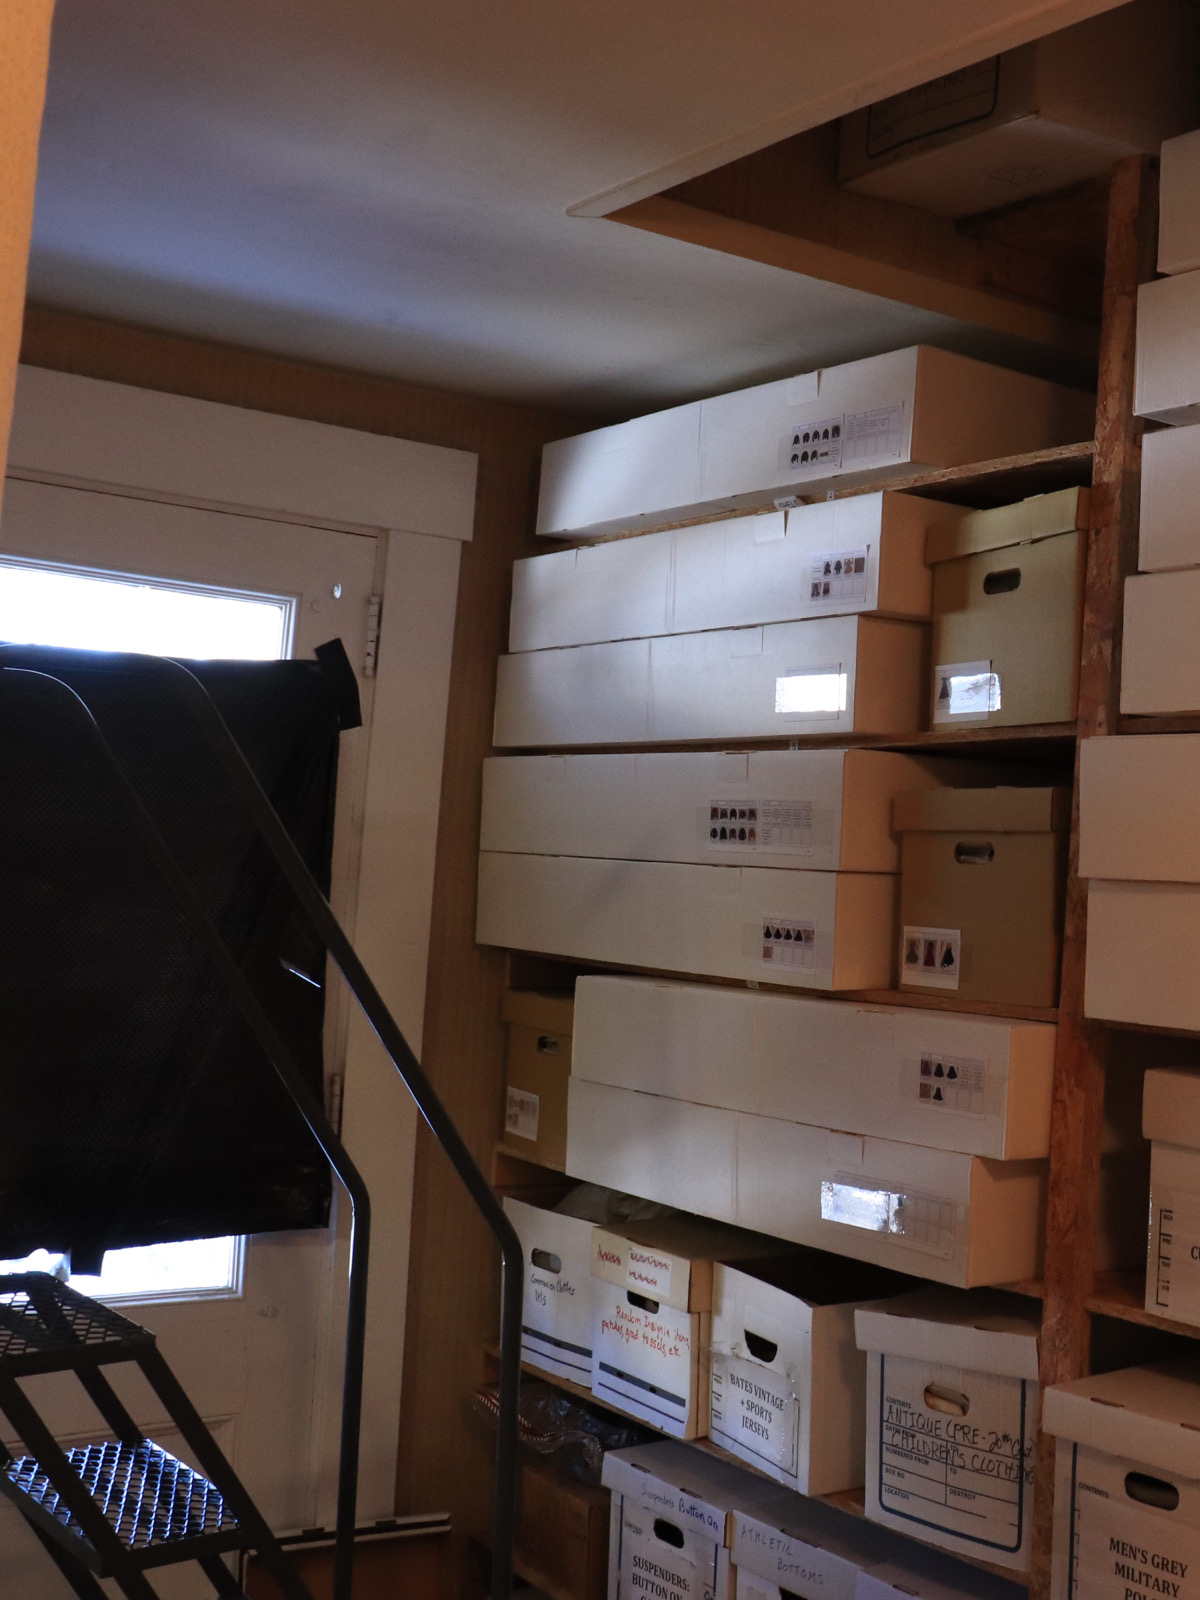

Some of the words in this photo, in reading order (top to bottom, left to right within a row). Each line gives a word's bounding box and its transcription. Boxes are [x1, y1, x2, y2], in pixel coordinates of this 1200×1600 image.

[616, 1305, 642, 1325] Random
[730, 1373, 753, 1395] BATES
[754, 1385, 784, 1412] VINTAGE
[886, 1396, 912, 1409] CONTENTS
[746, 1400, 772, 1424] SPORTS
[886, 1405, 942, 1438] ANTIQUE
[742, 1415, 769, 1441] JERSEYS
[886, 1447, 914, 1461] NUMBERED
[914, 1455, 930, 1466] FROM
[891, 1432, 966, 1469] CHILDREN'S
[971, 1454, 1037, 1485] CLOTHING
[885, 1467, 896, 1476] BOX
[950, 1467, 958, 1475] TO
[885, 1487, 910, 1500] LOCATION
[950, 1488, 977, 1501] DESTROY
[678, 1498, 706, 1524] Button
[707, 1515, 719, 1532] On
[741, 1524, 793, 1556] ATHLETIC
[777, 1558, 824, 1585] BOTTOMS
[1109, 1537, 1148, 1565] MEN'S
[1151, 1553, 1189, 1579] GREY
[632, 1555, 690, 1592] SUSPENDERS:
[632, 1573, 669, 1600] BUTTON
[1114, 1561, 1181, 1599] MILITARY
